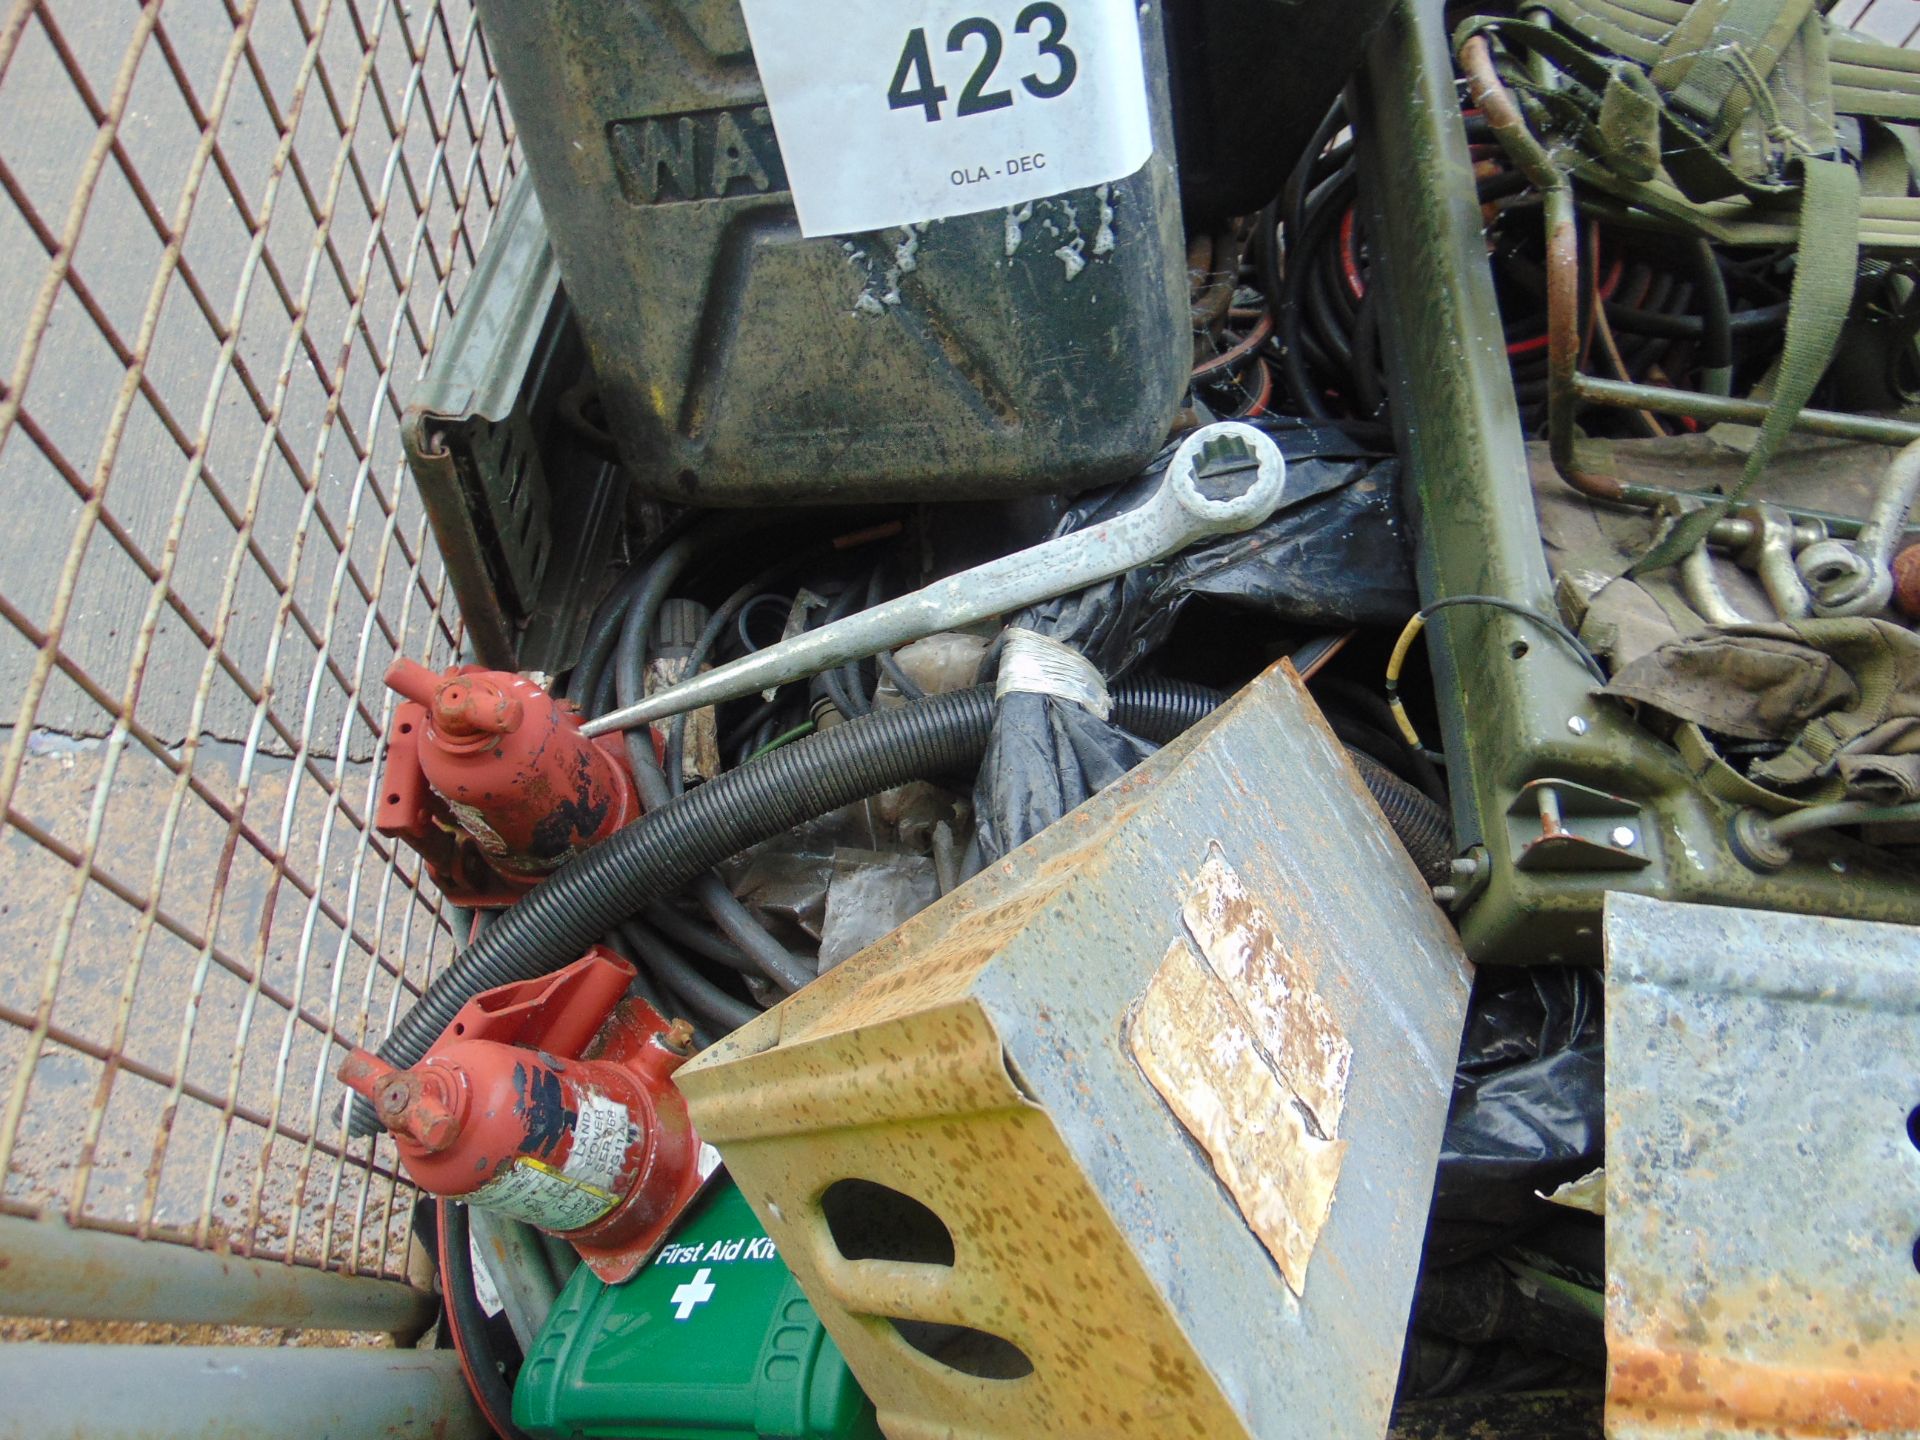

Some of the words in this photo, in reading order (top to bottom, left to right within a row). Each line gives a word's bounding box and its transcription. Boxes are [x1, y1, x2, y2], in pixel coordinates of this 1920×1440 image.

[887, 1, 1077, 122] 423
[613, 104, 773, 199] WA
[951, 166, 990, 185] OLA
[1006, 153, 1046, 175] DEC
[575, 1111, 591, 1157] LAND
[655, 1242, 704, 1265] First
[702, 1239, 745, 1261] Aid
